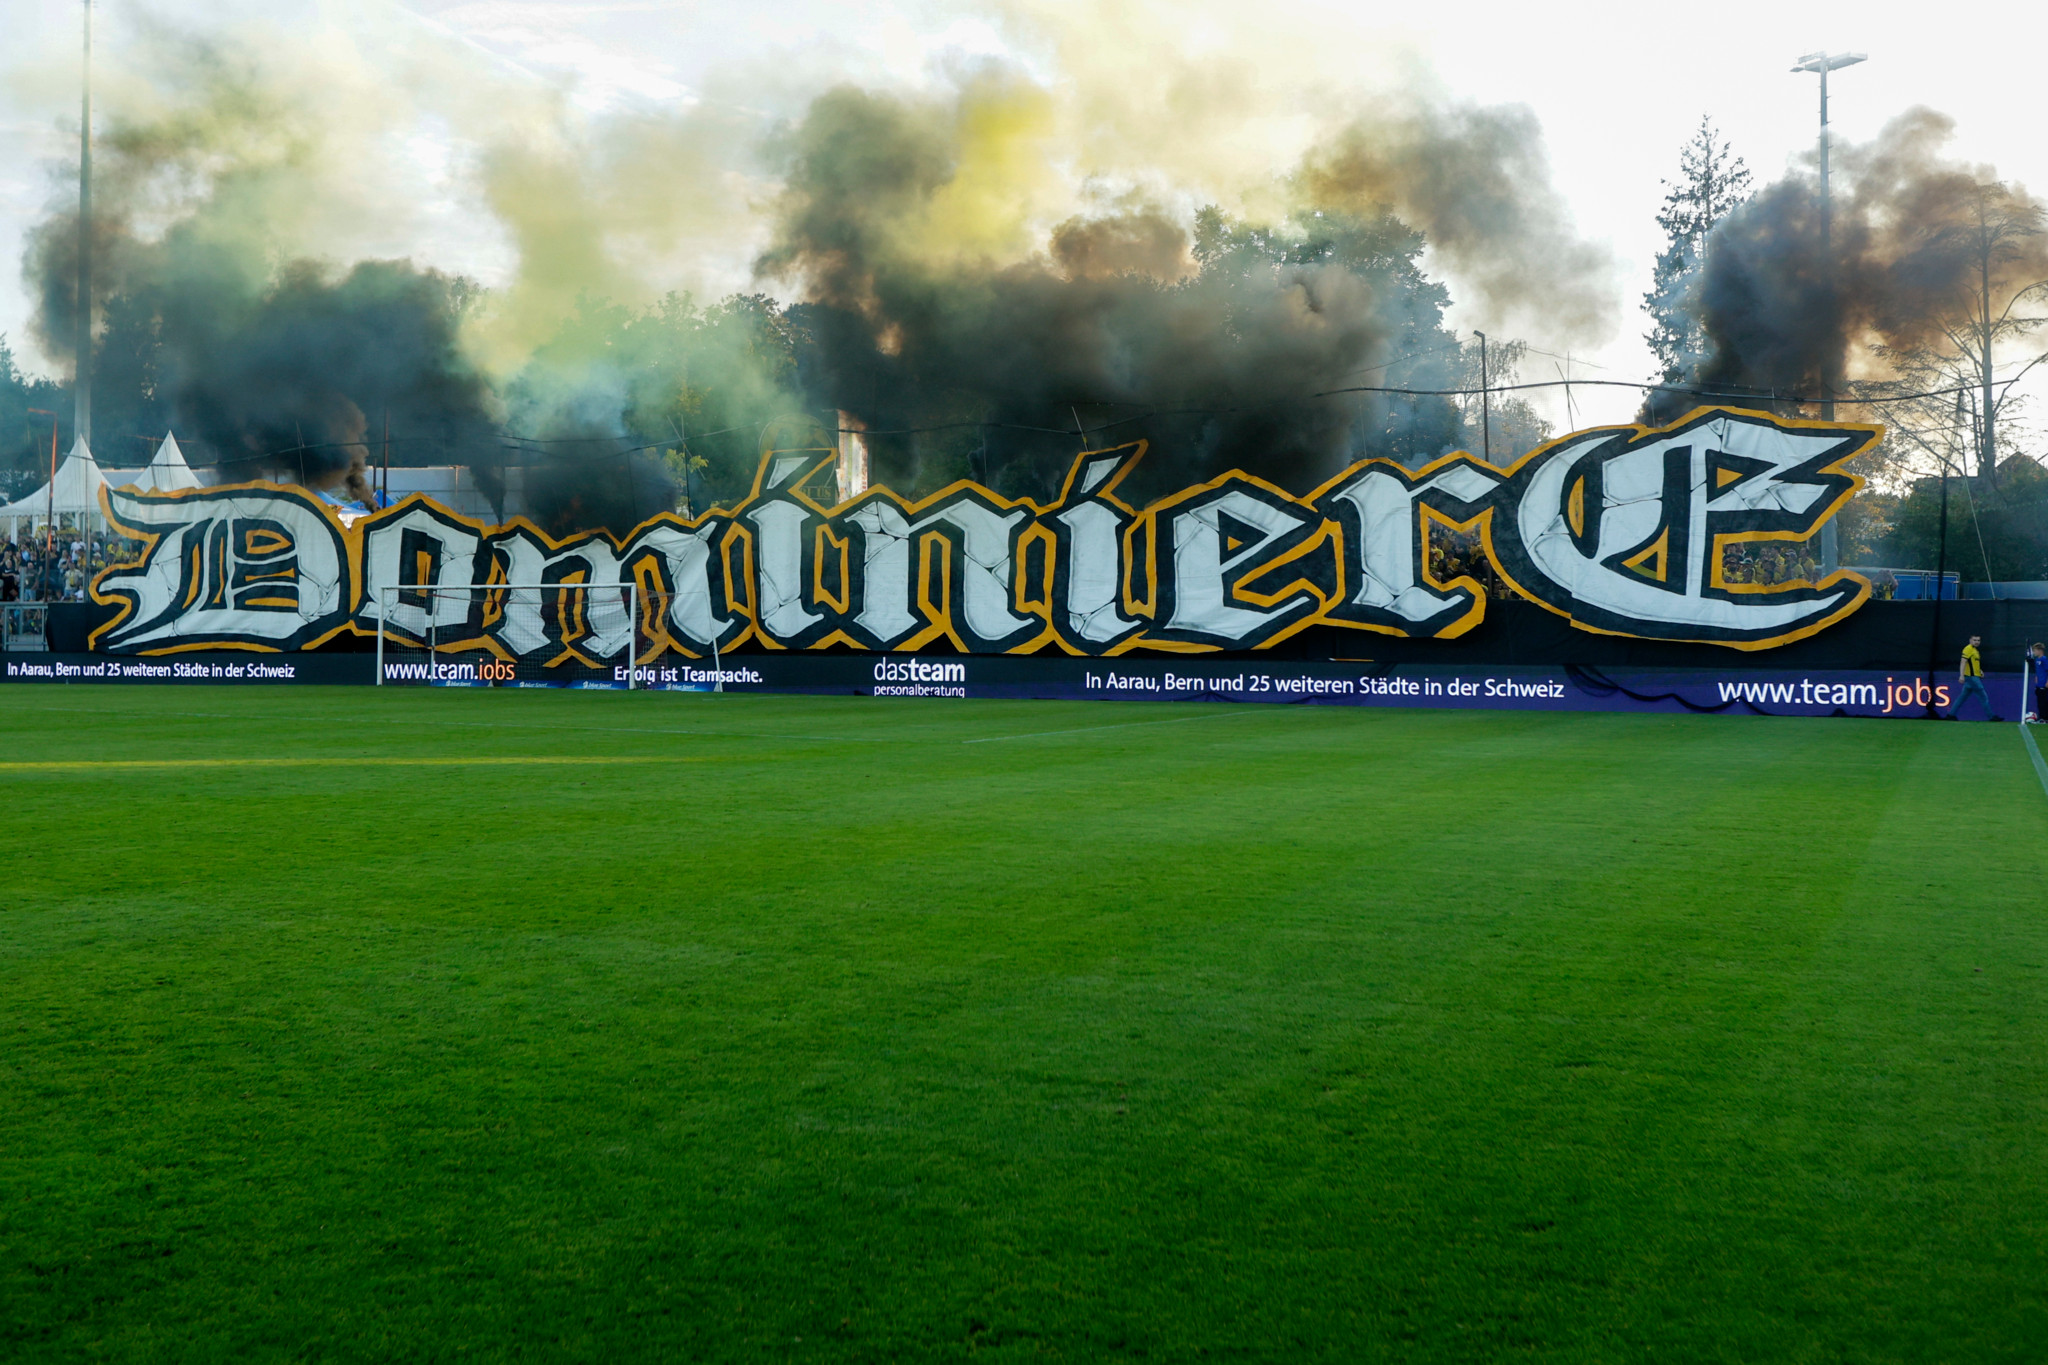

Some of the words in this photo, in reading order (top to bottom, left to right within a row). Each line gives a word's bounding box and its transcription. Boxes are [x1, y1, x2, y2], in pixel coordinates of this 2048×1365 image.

[7, 662, 18, 676] In
[20, 662, 54, 679] Aarau,
[56, 662, 81, 676] Bern
[83, 662, 105, 677] und
[107, 663, 121, 677] 25
[122, 663, 171, 677] weiteren
[173, 662, 210, 678] Städte
[212, 663, 223, 677] in
[225, 663, 246, 678] der
[247, 663, 295, 678] Schweiz
[614, 665, 656, 685] Erolg
[660, 666, 679, 682] ist
[682, 665, 763, 683] Teamsache.
[873, 656, 966, 682] dasteam
[873, 683, 966, 698] personalberatung
[1085, 672, 1101, 689] In
[1105, 672, 1161, 693] Aarau,
[1165, 673, 1205, 691] Bern
[1209, 674, 1244, 692] und
[1248, 675, 1270, 692] 25
[1274, 675, 1354, 695] weiteren
[1359, 676, 1420, 696] Städte
[1424, 678, 1443, 696] in
[1447, 678, 1481, 696] der
[1484, 679, 1565, 698] Schweiz
[1717, 677, 1951, 714] www.team.jobs
